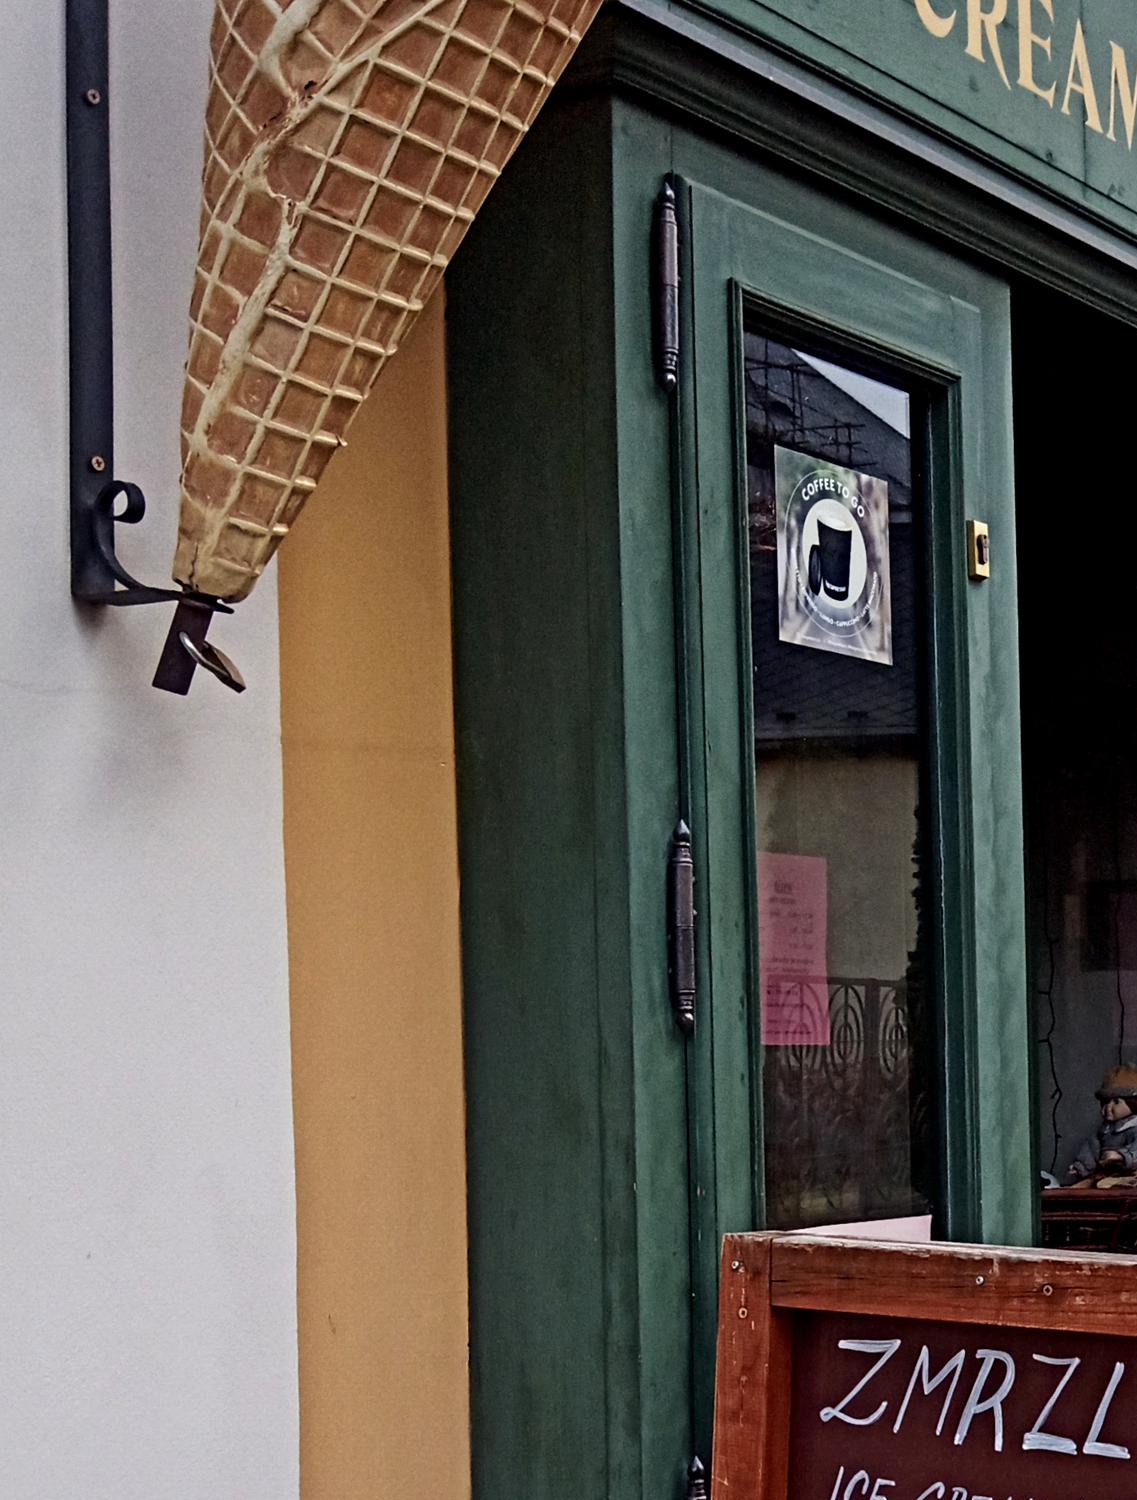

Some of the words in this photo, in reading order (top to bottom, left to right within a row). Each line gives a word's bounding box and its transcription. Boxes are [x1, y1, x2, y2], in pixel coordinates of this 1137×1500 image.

[802, 478, 835, 501] COFFEE
[837, 482, 850, 498] TO
[851, 496, 865, 518] GO
